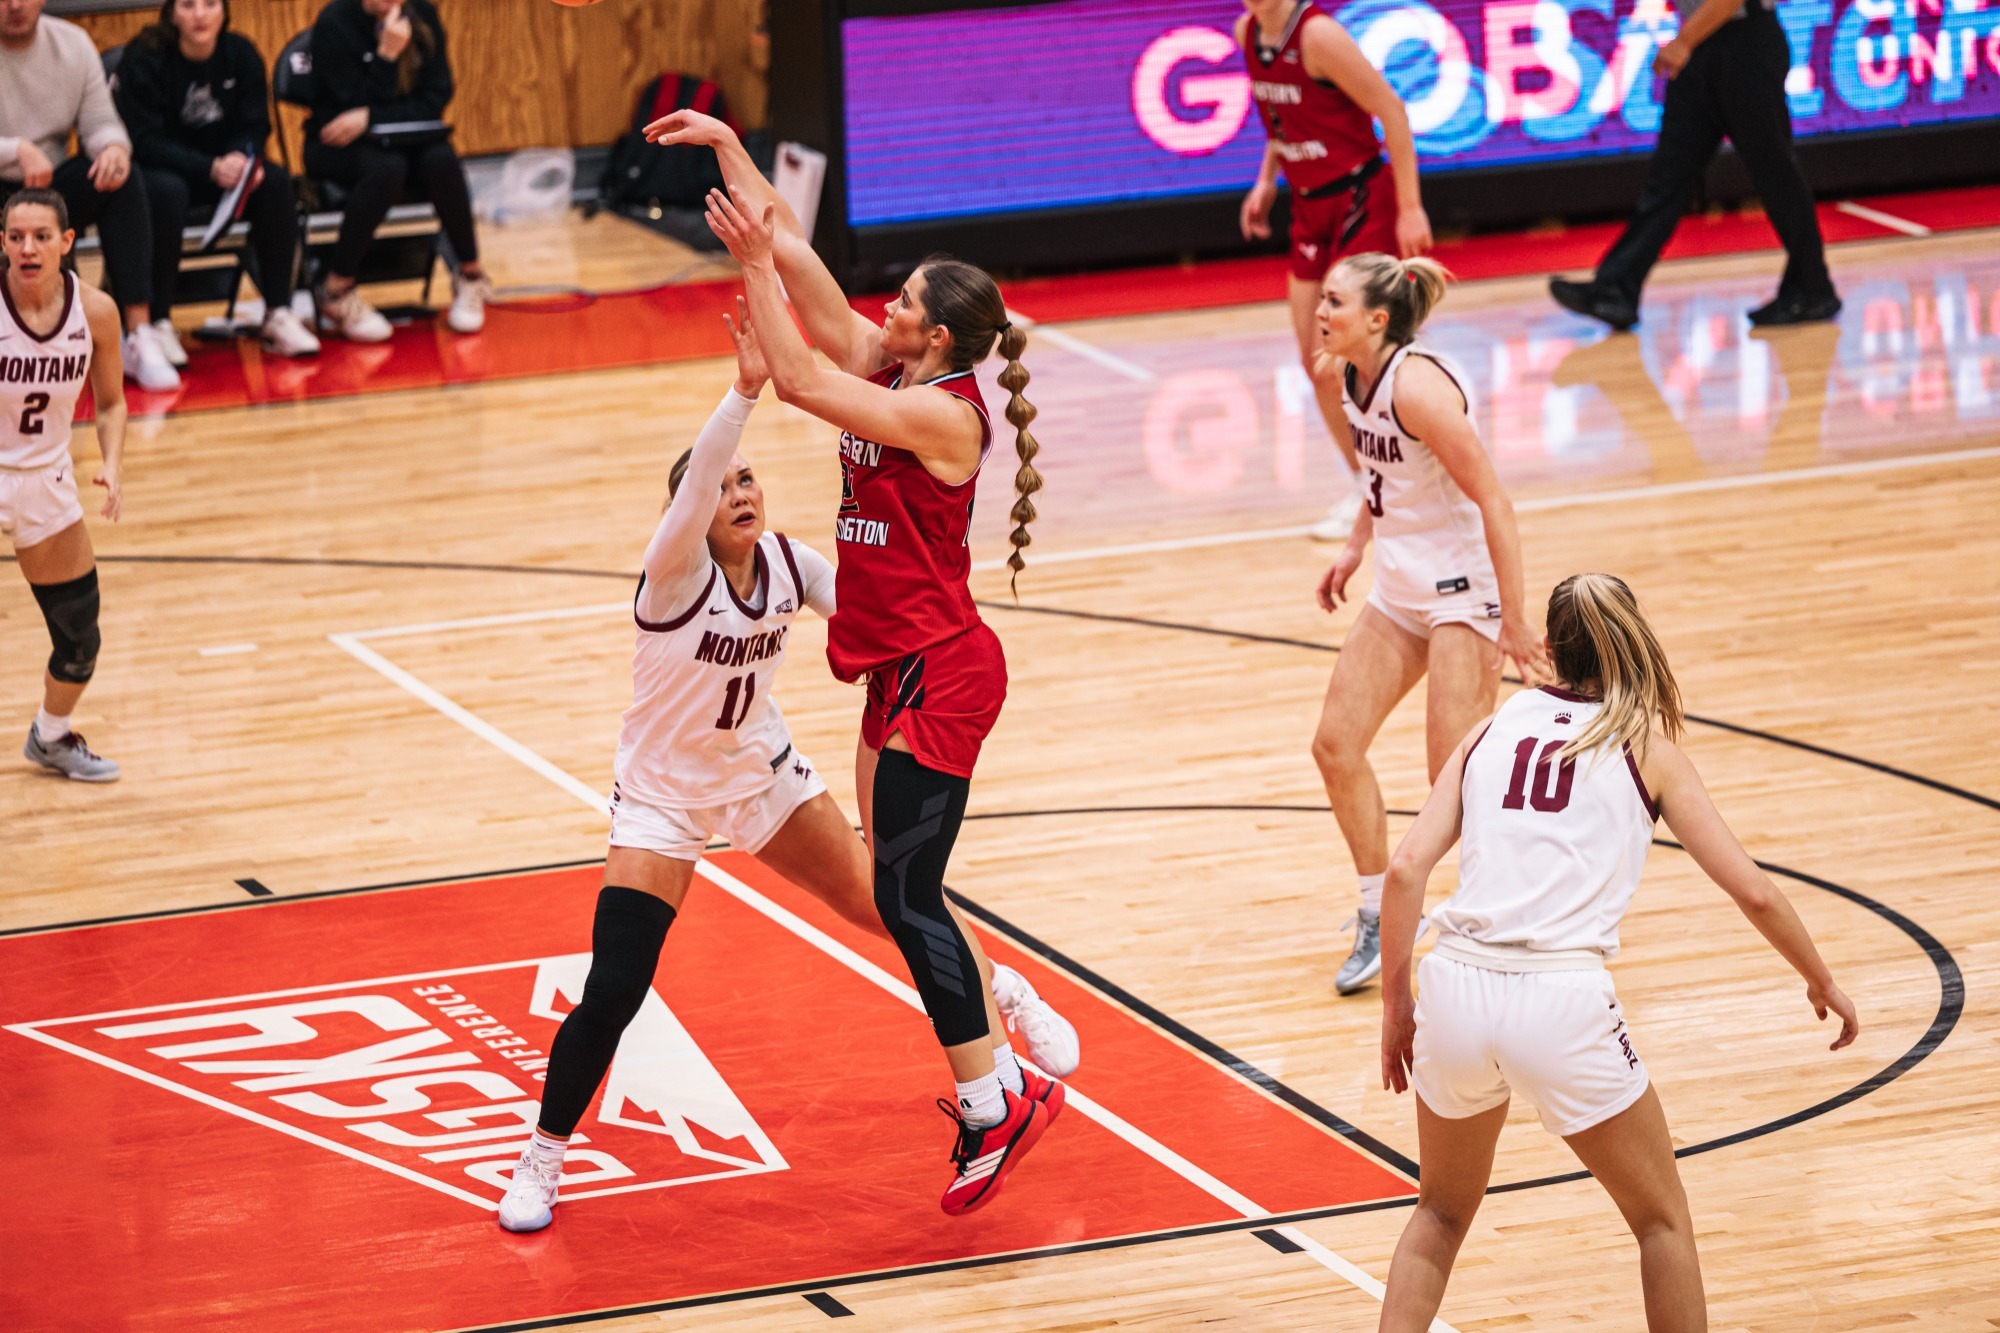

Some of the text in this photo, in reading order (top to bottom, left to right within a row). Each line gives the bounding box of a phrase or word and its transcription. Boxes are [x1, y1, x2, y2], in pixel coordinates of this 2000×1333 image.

[19, 391, 51, 435] 2
[1367, 467, 1384, 518] 3
[715, 672, 755, 730] 11
[1502, 736, 1576, 813] 10
